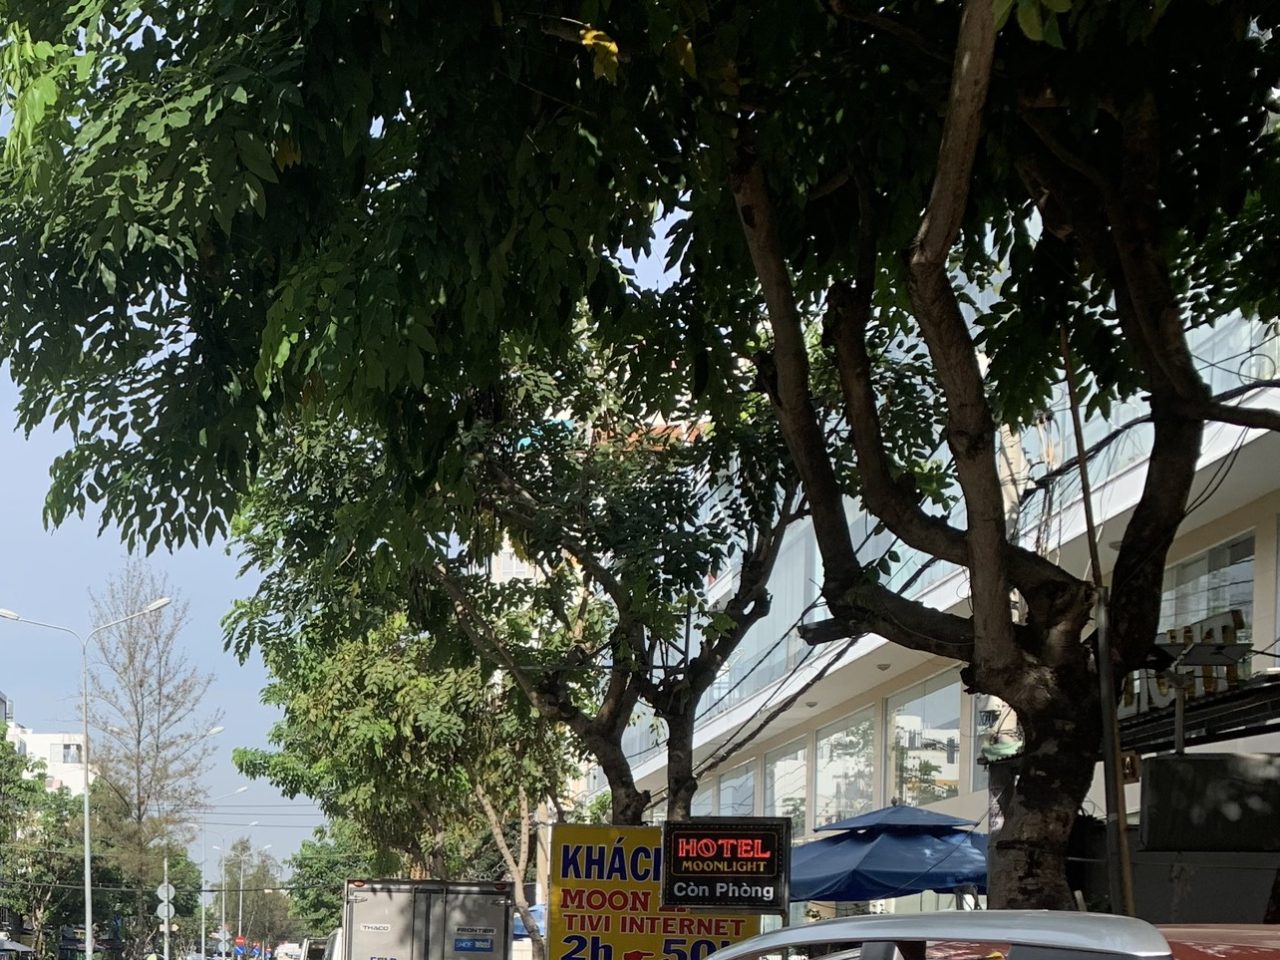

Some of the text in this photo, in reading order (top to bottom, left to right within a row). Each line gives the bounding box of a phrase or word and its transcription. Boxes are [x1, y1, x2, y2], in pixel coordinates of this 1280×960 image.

[678, 838, 771, 858] HOTEL
[681, 860, 767, 873] MOONLIGHT
[561, 888, 652, 912] MOON
[673, 880, 775, 900] Còn Phòng
[563, 914, 746, 936] TIVI INTERNET
